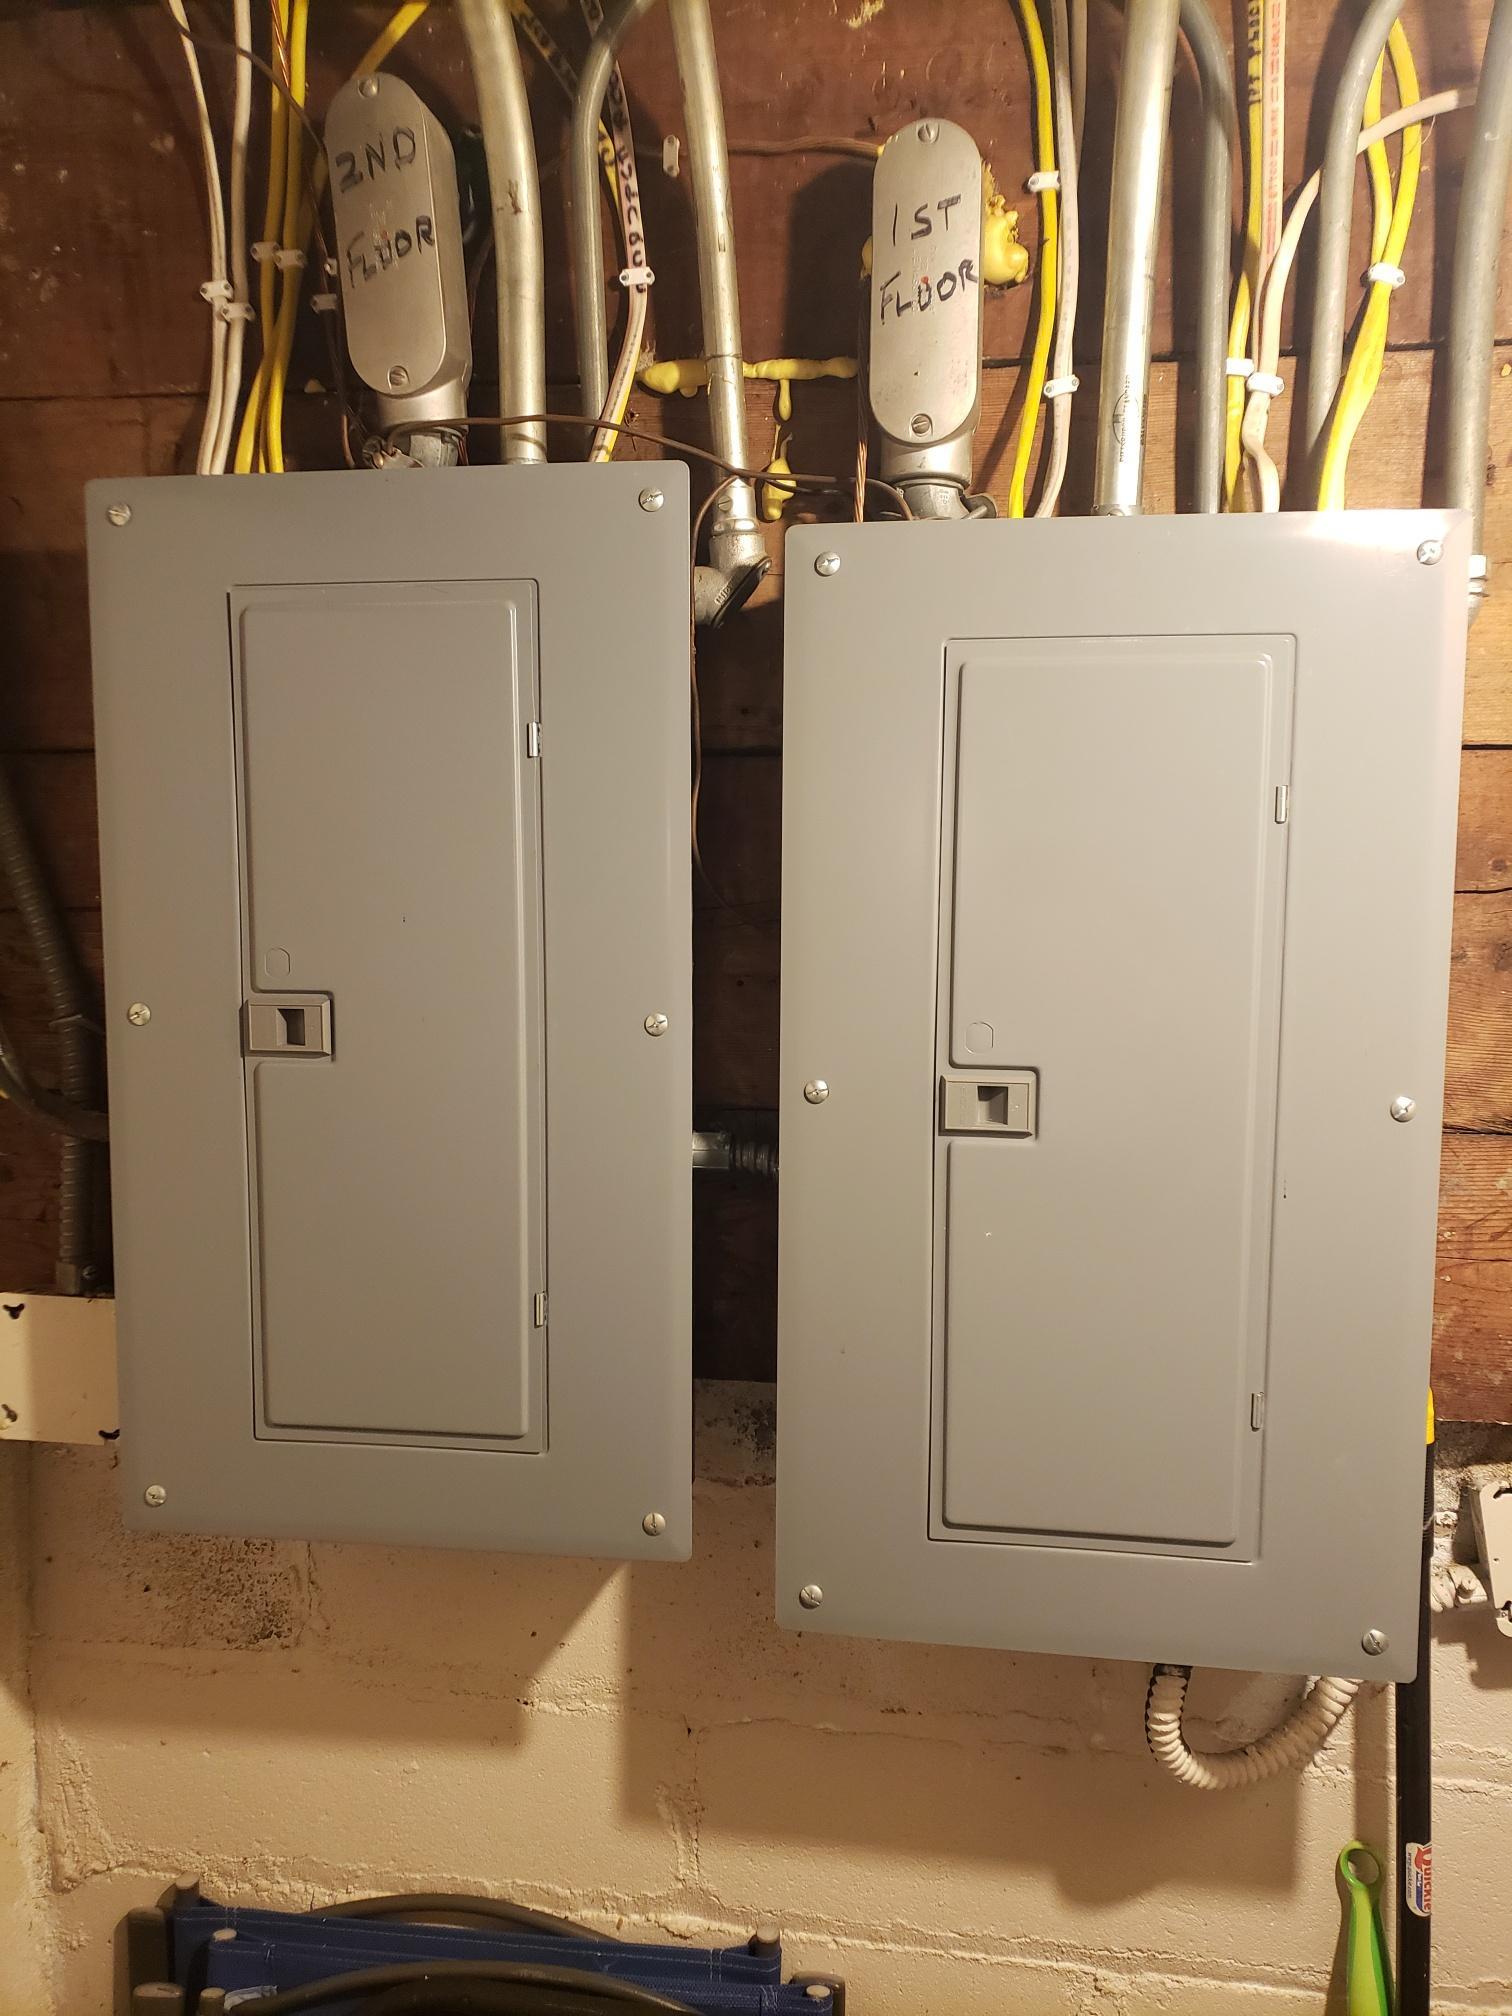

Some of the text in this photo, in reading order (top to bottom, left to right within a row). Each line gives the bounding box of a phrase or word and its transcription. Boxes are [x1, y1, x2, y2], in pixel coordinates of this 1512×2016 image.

[335, 126, 416, 194] 2ND
[347, 215, 436, 289] FLOOR
[891, 194, 961, 247] 1ST
[880, 259, 979, 325] FLOOR
